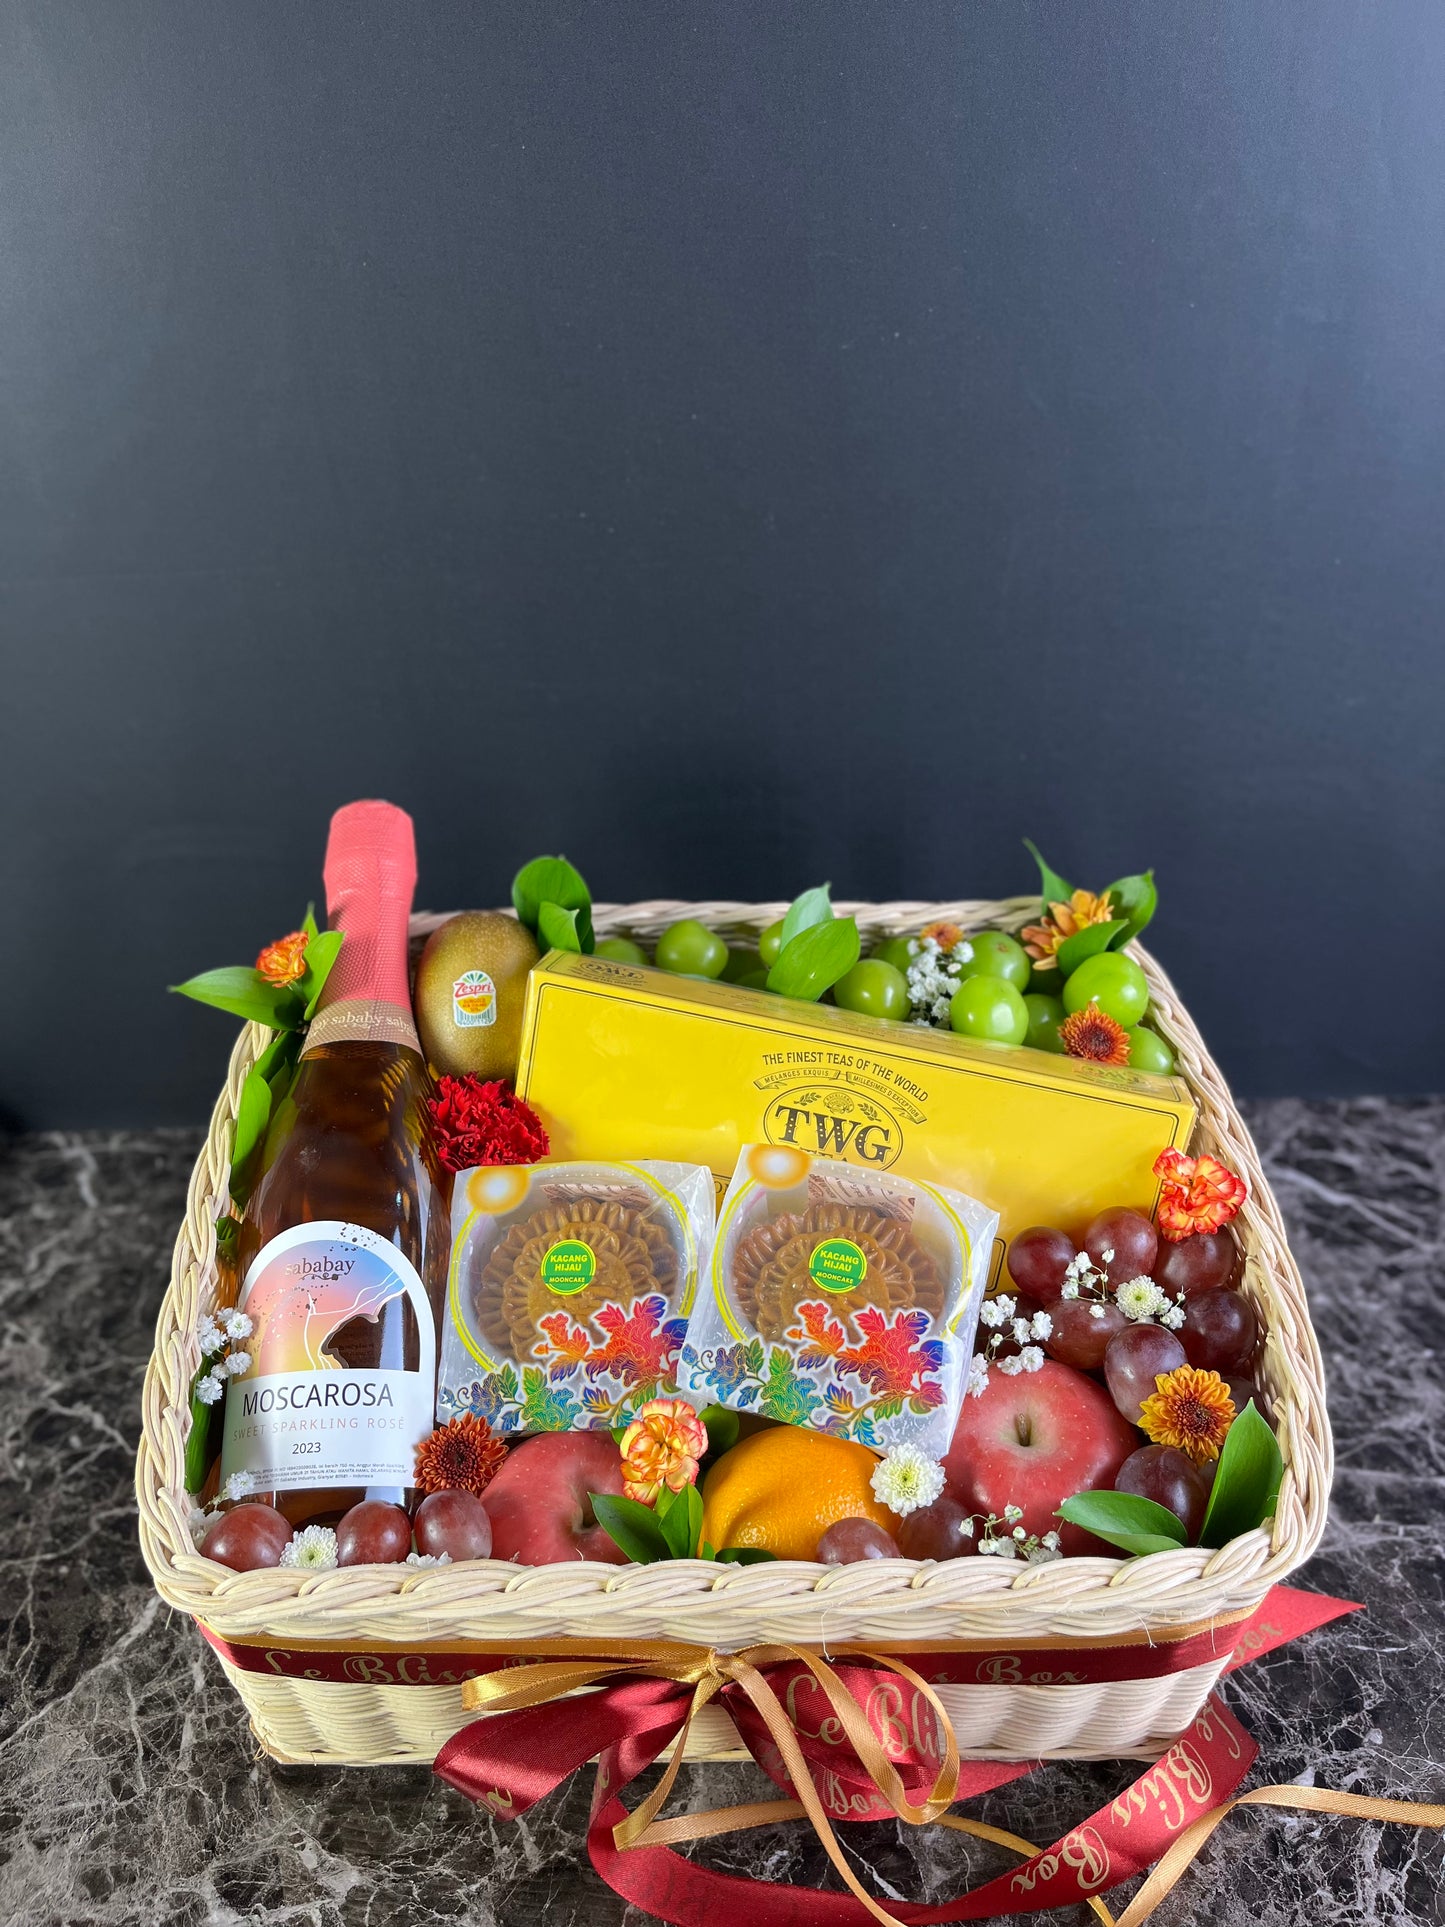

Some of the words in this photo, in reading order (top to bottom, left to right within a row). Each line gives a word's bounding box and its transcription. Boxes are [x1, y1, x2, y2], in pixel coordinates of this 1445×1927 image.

[454, 982, 493, 998] Zespri
[762, 1053, 784, 1066] THE
[786, 1051, 824, 1064] FINEST
[827, 1052, 854, 1067] TEAS
[856, 1058, 872, 1071] OF
[872, 1063, 892, 1081] THE
[893, 1073, 929, 1103] WORLD
[803, 1069, 830, 1078] EXQUIS
[775, 1104, 892, 1163] TWG
[284, 1256, 356, 1276] sababay
[550, 1254, 588, 1263] KACANG
[554, 1263, 582, 1272] HIJAU
[820, 1249, 860, 1265] KACANG
[823, 1259, 852, 1272] HIJAU
[815, 1271, 854, 1284] MOONCAKE
[242, 1382, 394, 1417] MOSCAROSA
[233, 1424, 266, 1442] SWEET
[272, 1417, 358, 1434] SPARKLING
[292, 1442, 321, 1455] 2023
[265, 1651, 330, 1680] Le
[975, 1655, 1088, 1685] Box
[1196, 1703, 1241, 1760] Le
[1111, 1739, 1213, 1831] Bliss
[1010, 1825, 1111, 1895] Box
